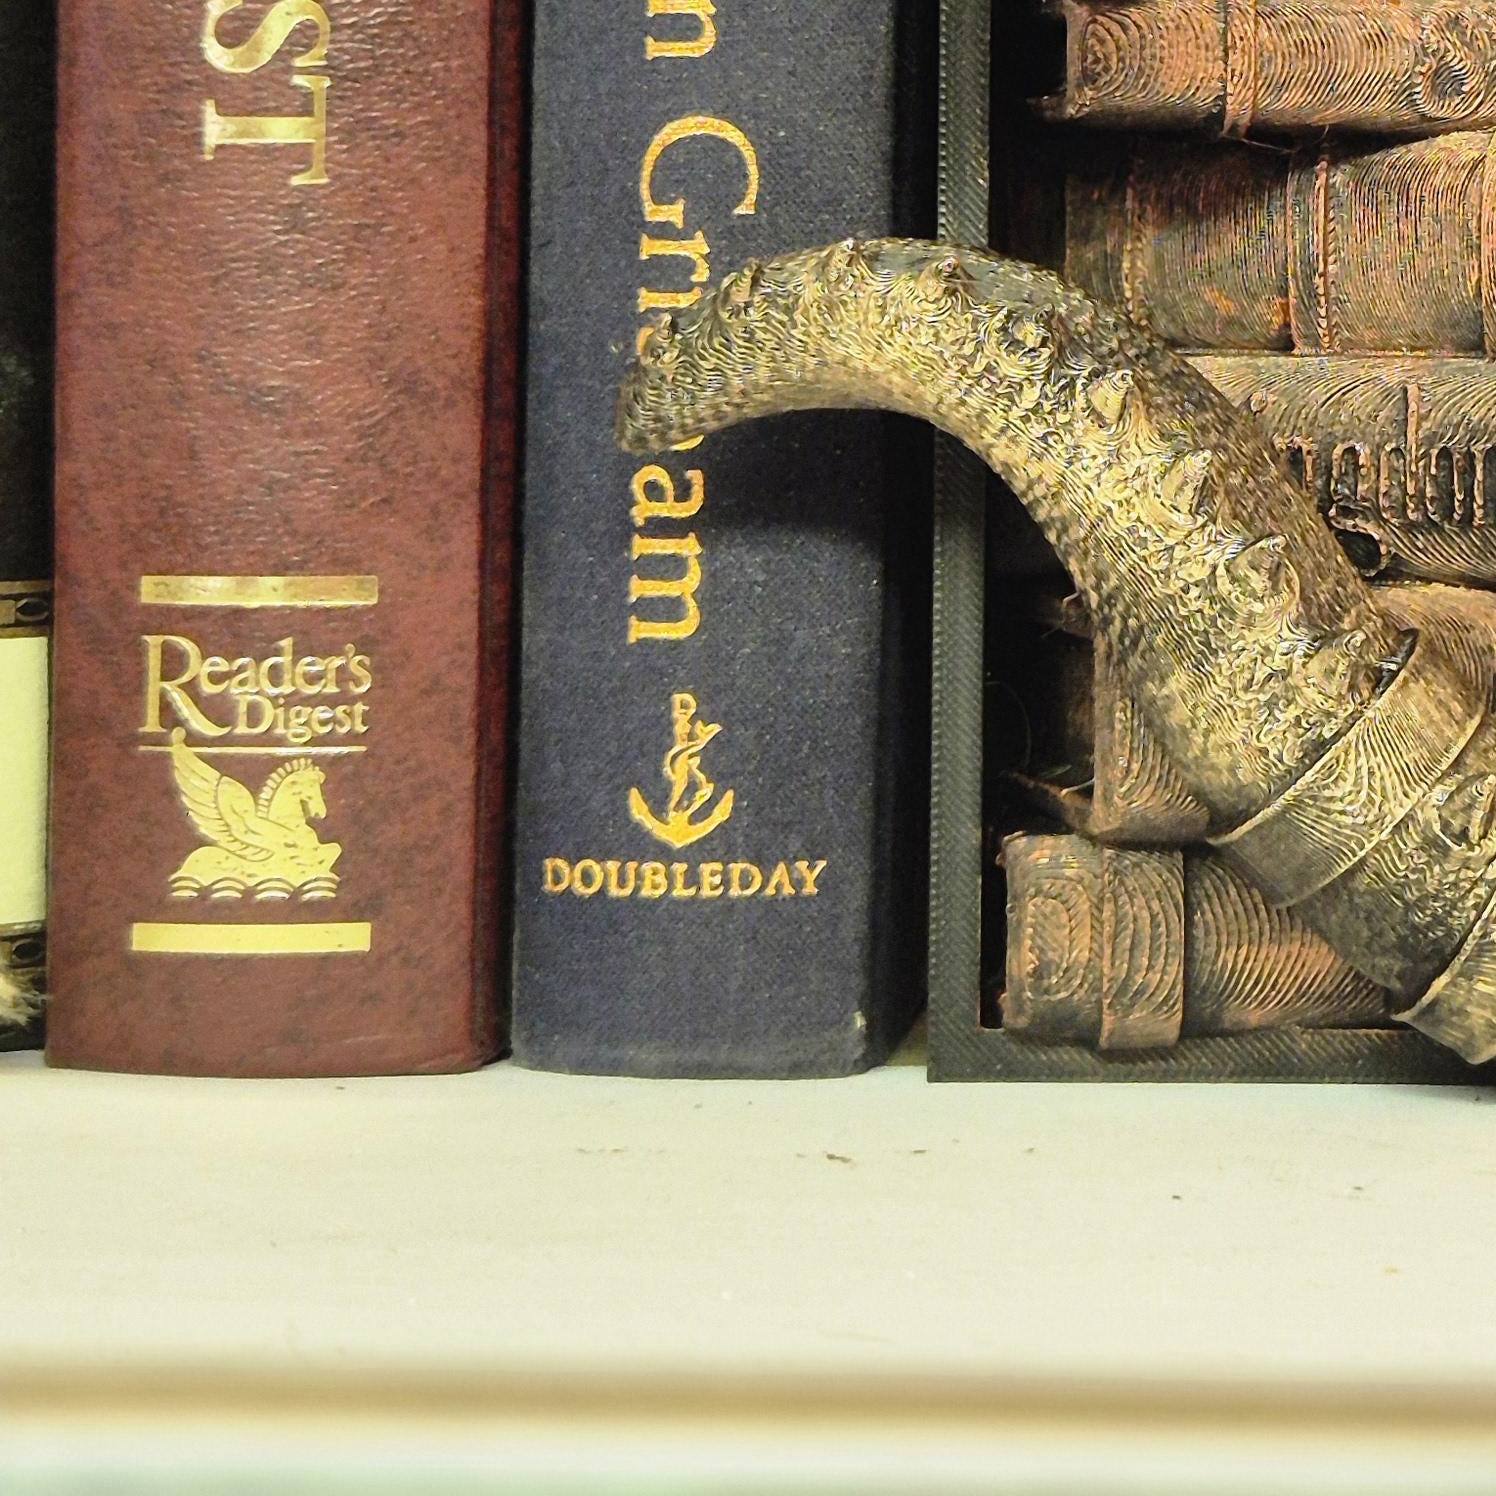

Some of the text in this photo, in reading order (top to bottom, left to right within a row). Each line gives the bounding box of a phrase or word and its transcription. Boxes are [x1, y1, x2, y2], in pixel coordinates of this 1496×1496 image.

[626, 115, 760, 645] Griam
[137, 634, 374, 737] Reader's
[234, 693, 370, 743] Digest
[542, 857, 828, 898] DOUBLEDAY
